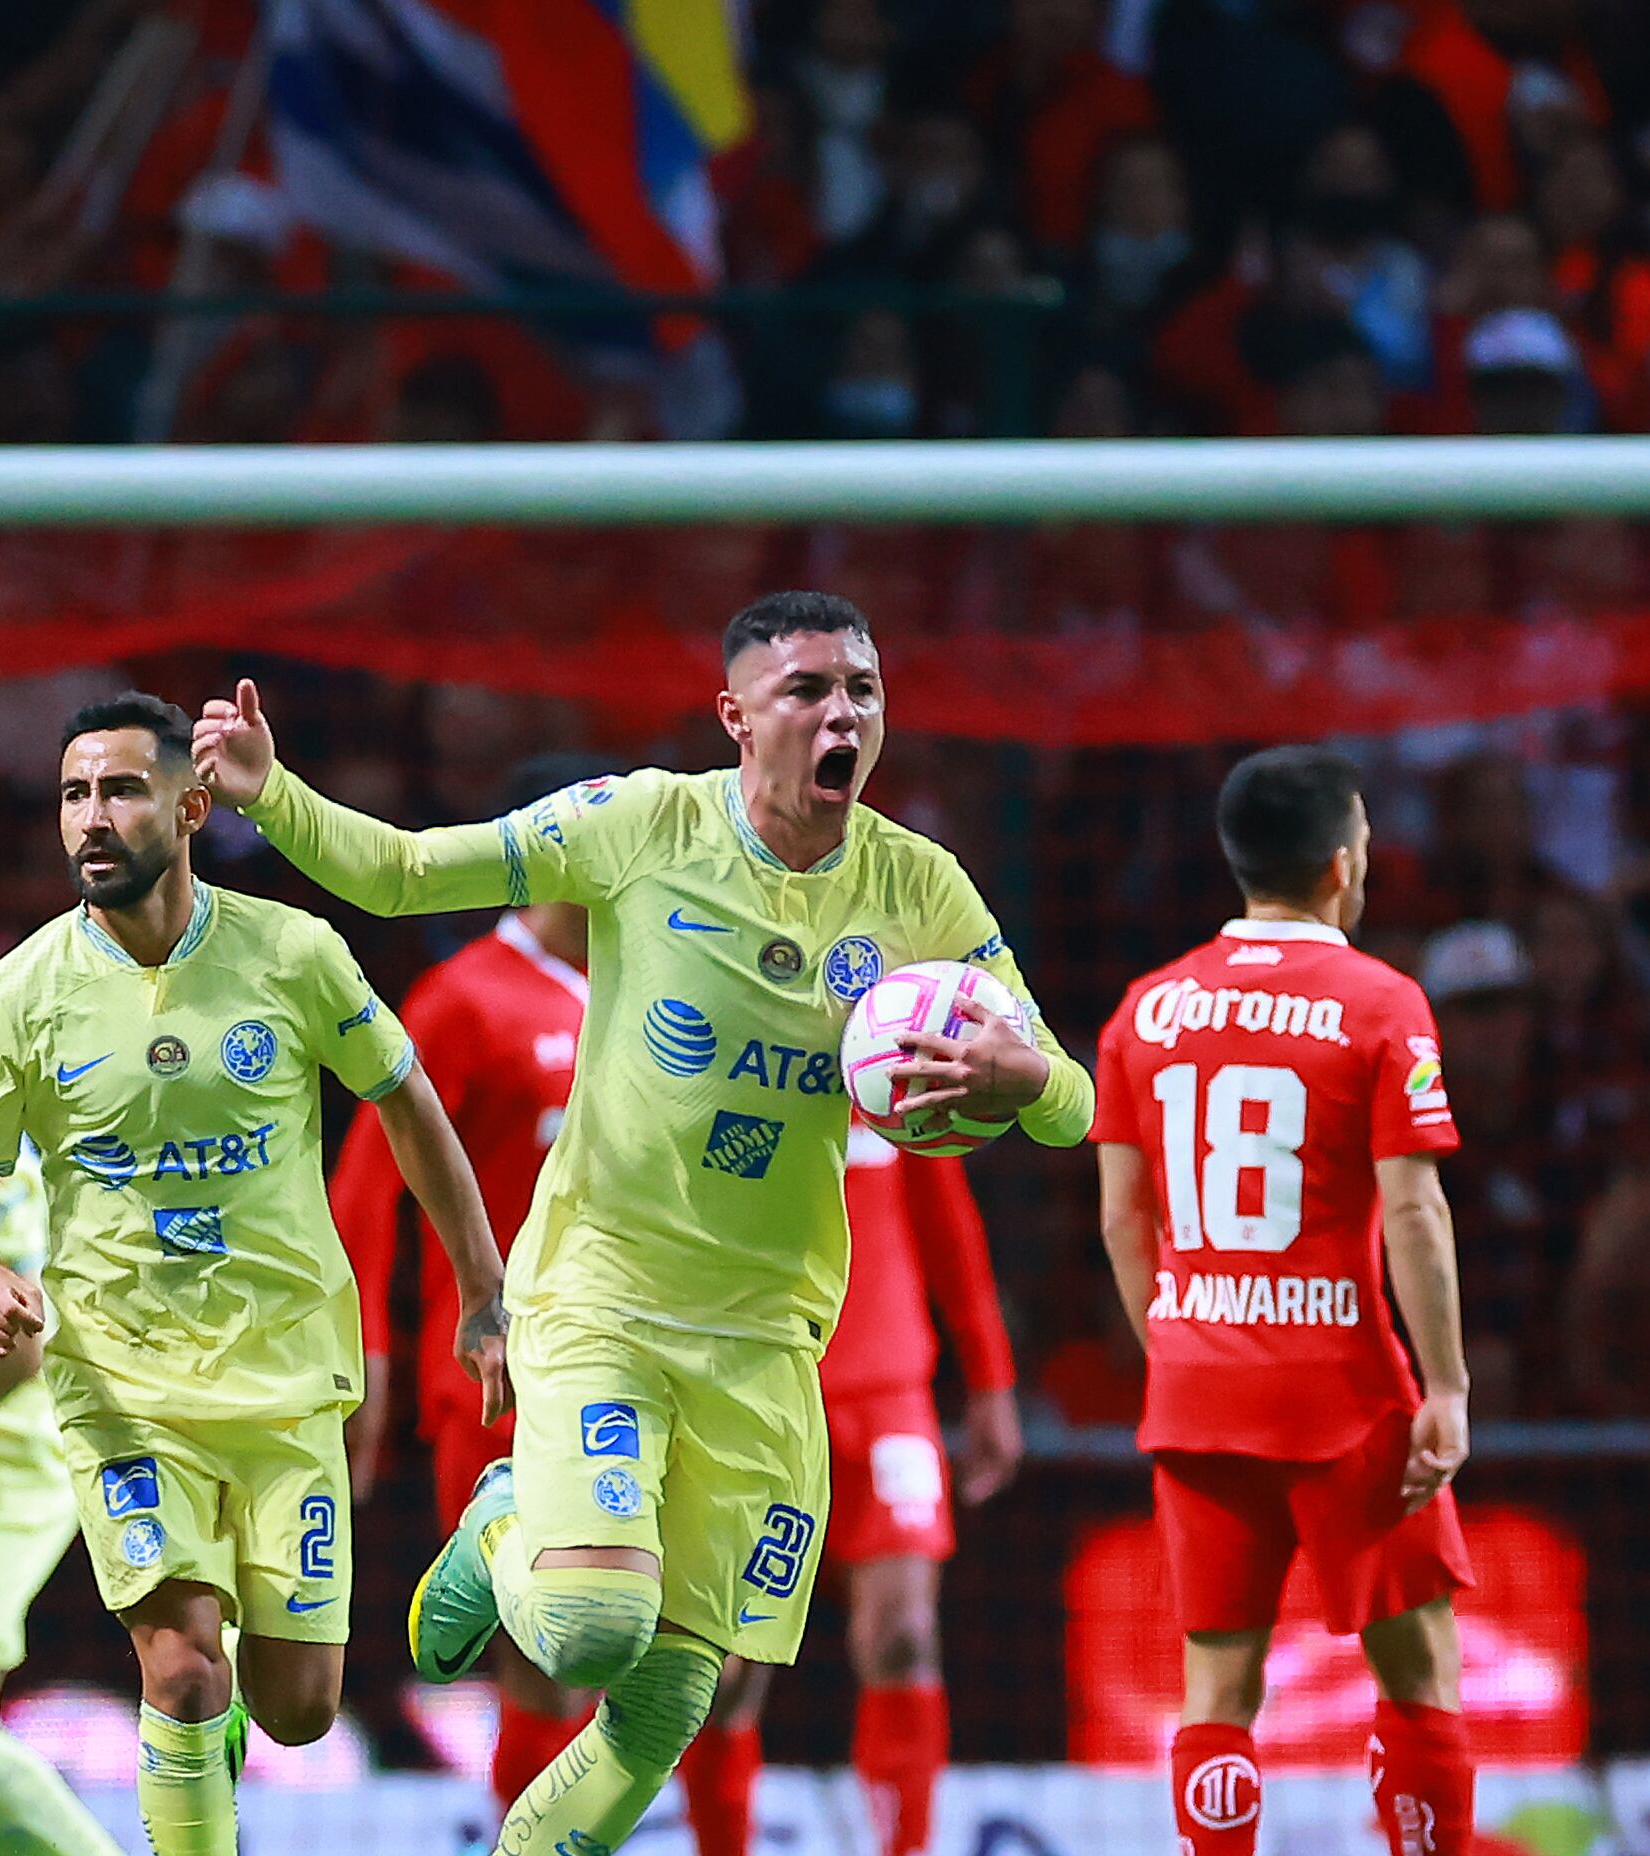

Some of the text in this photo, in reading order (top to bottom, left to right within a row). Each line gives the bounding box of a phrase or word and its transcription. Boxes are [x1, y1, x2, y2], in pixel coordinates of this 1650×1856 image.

[1134, 976, 1343, 1049] Corona
[728, 1039, 847, 1095] AT&
[152, 1122, 275, 1181] AT&T
[1152, 1062, 1307, 1252] 18
[301, 1495, 336, 1580] 2
